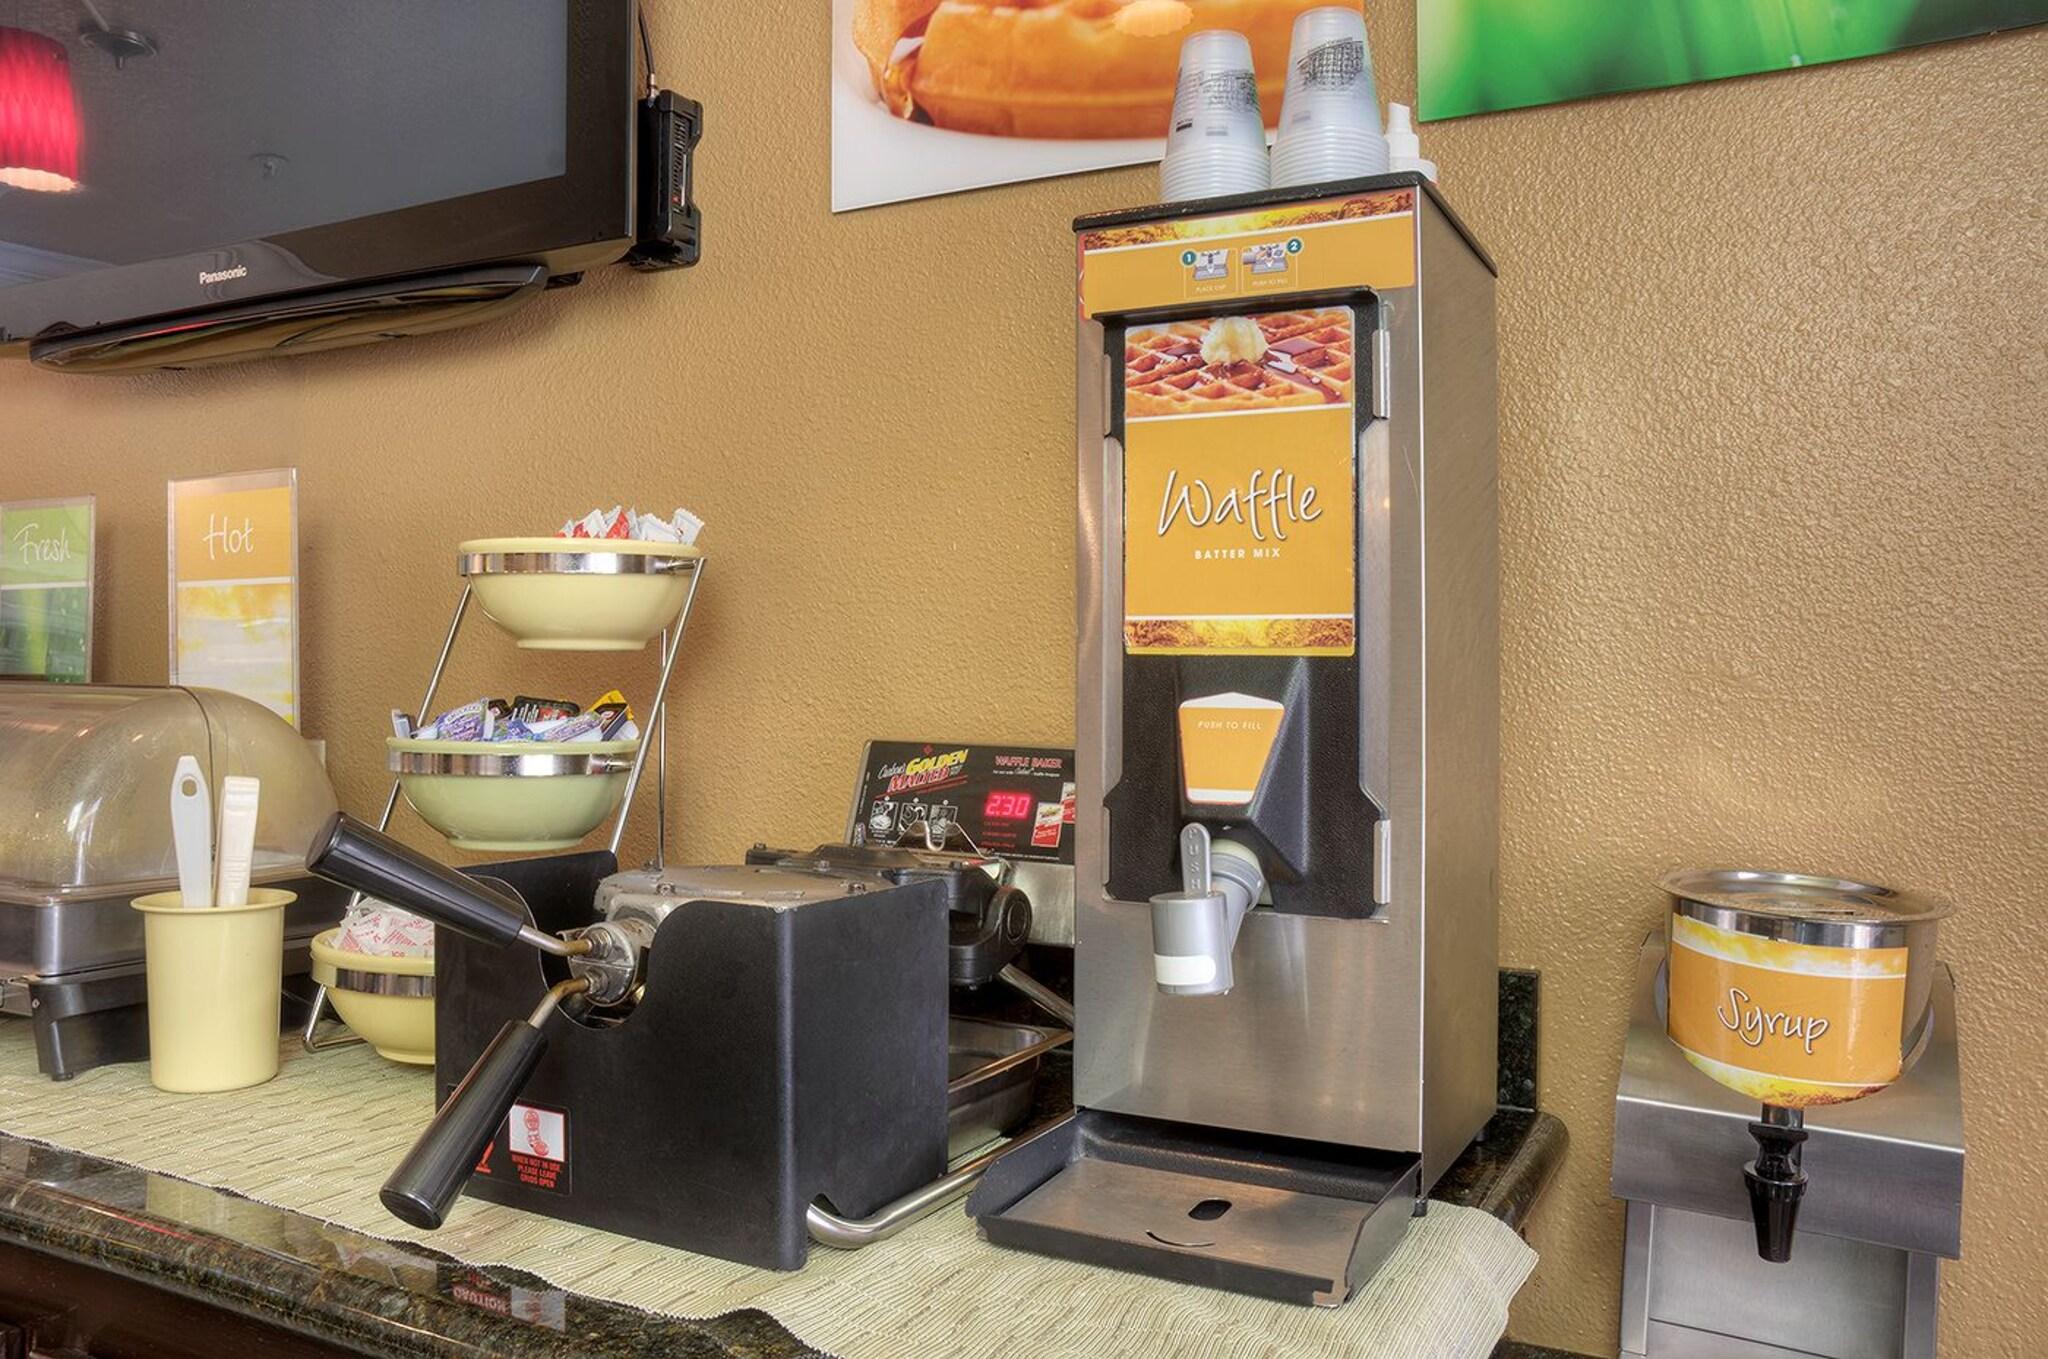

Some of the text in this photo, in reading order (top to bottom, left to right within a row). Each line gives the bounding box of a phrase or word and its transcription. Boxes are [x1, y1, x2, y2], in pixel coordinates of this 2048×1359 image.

[1290, 242, 1298, 251] 2
[199, 264, 248, 284] Panasonic
[1157, 468, 1323, 541] Waffle
[13, 522, 72, 565] Fresh
[202, 513, 255, 561] Hot
[1194, 547, 1281, 560] BATTER MIX
[1197, 720, 1263, 731] PUSH TO FILL
[905, 749, 969, 775] GOLDEN
[994, 754, 1063, 769] WAFFLE BAKER
[886, 766, 950, 793] MALTED
[984, 793, 1032, 818] 2:30
[1188, 826, 1201, 890] PUSH
[1717, 986, 1830, 1055] Syrup
